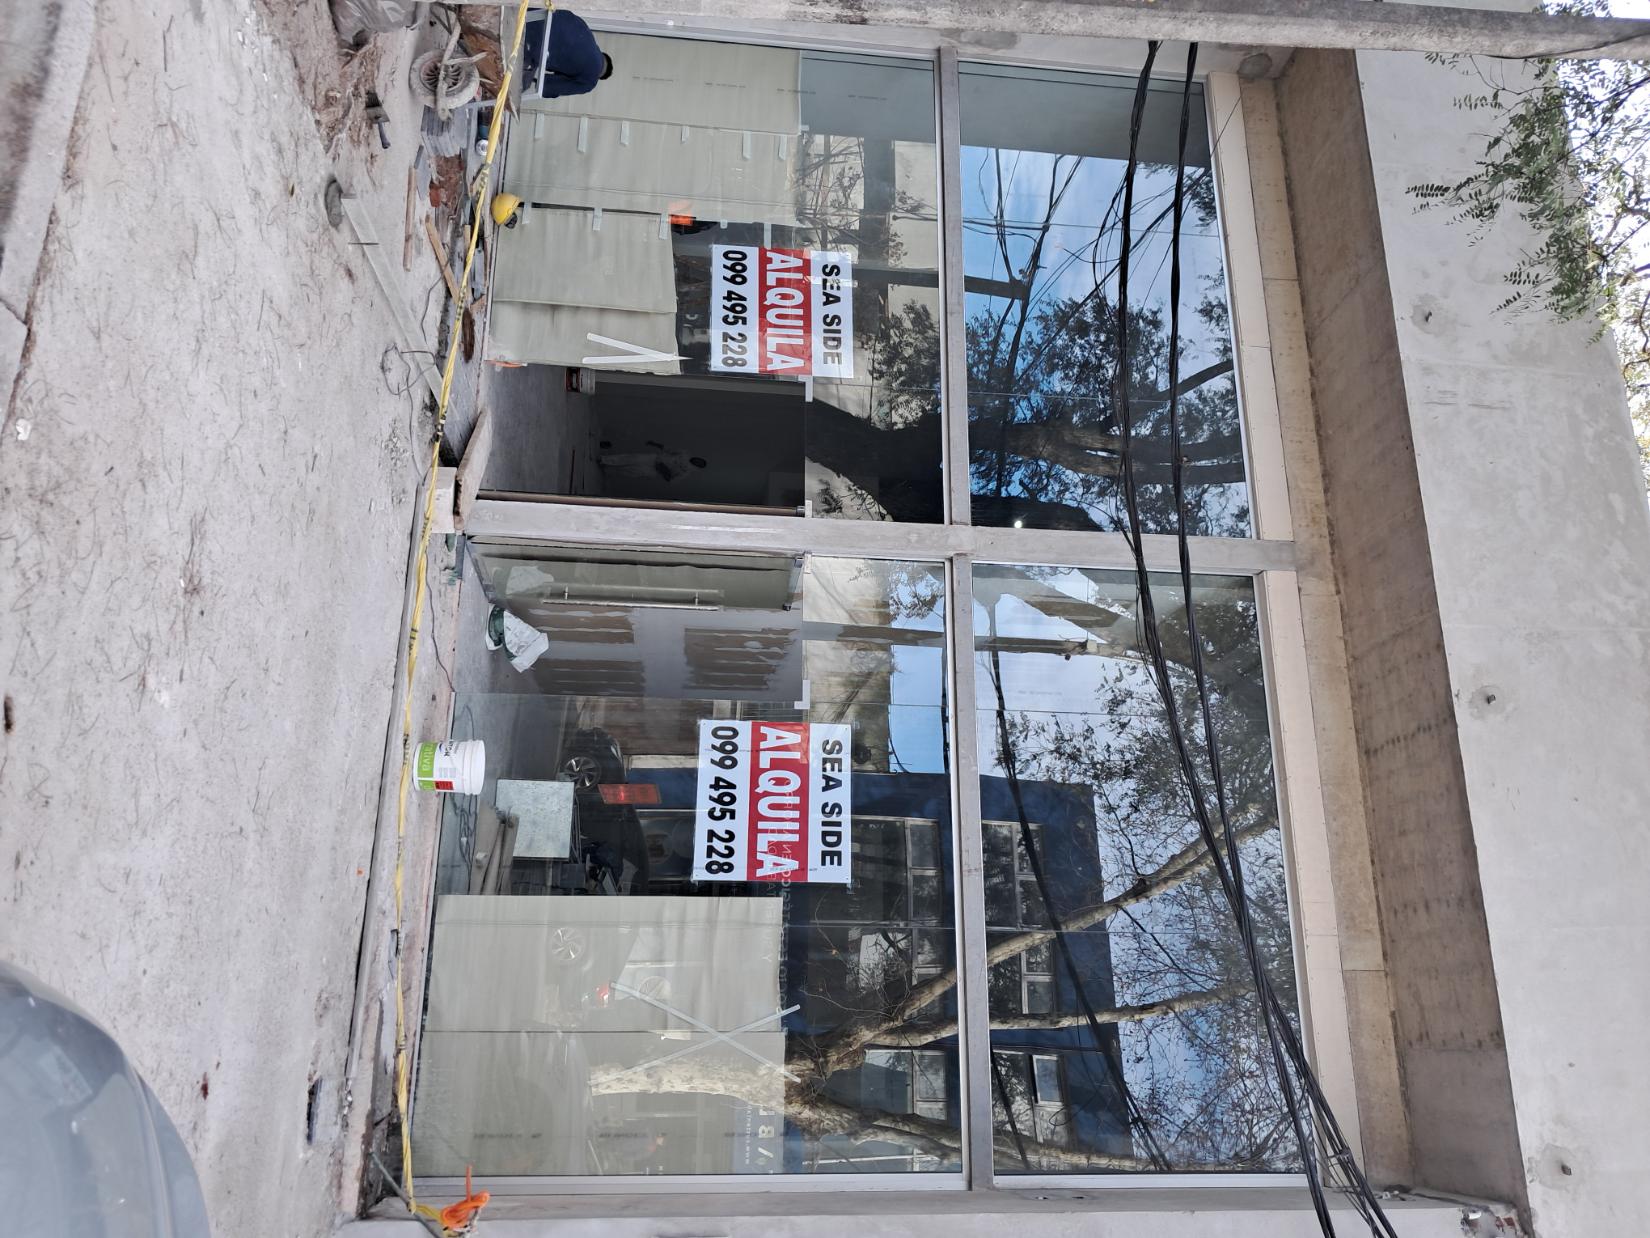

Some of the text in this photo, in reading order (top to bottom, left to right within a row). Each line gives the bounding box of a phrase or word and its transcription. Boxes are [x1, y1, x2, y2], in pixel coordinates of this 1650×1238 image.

[721, 250, 748, 367] 099 495 228
[763, 251, 805, 371] ALQUILA
[821, 263, 843, 365] SEA SIDE
[705, 726, 740, 875] 099 495 228
[754, 725, 802, 877] ALQUILA
[820, 738, 843, 867] SEA SIDE
